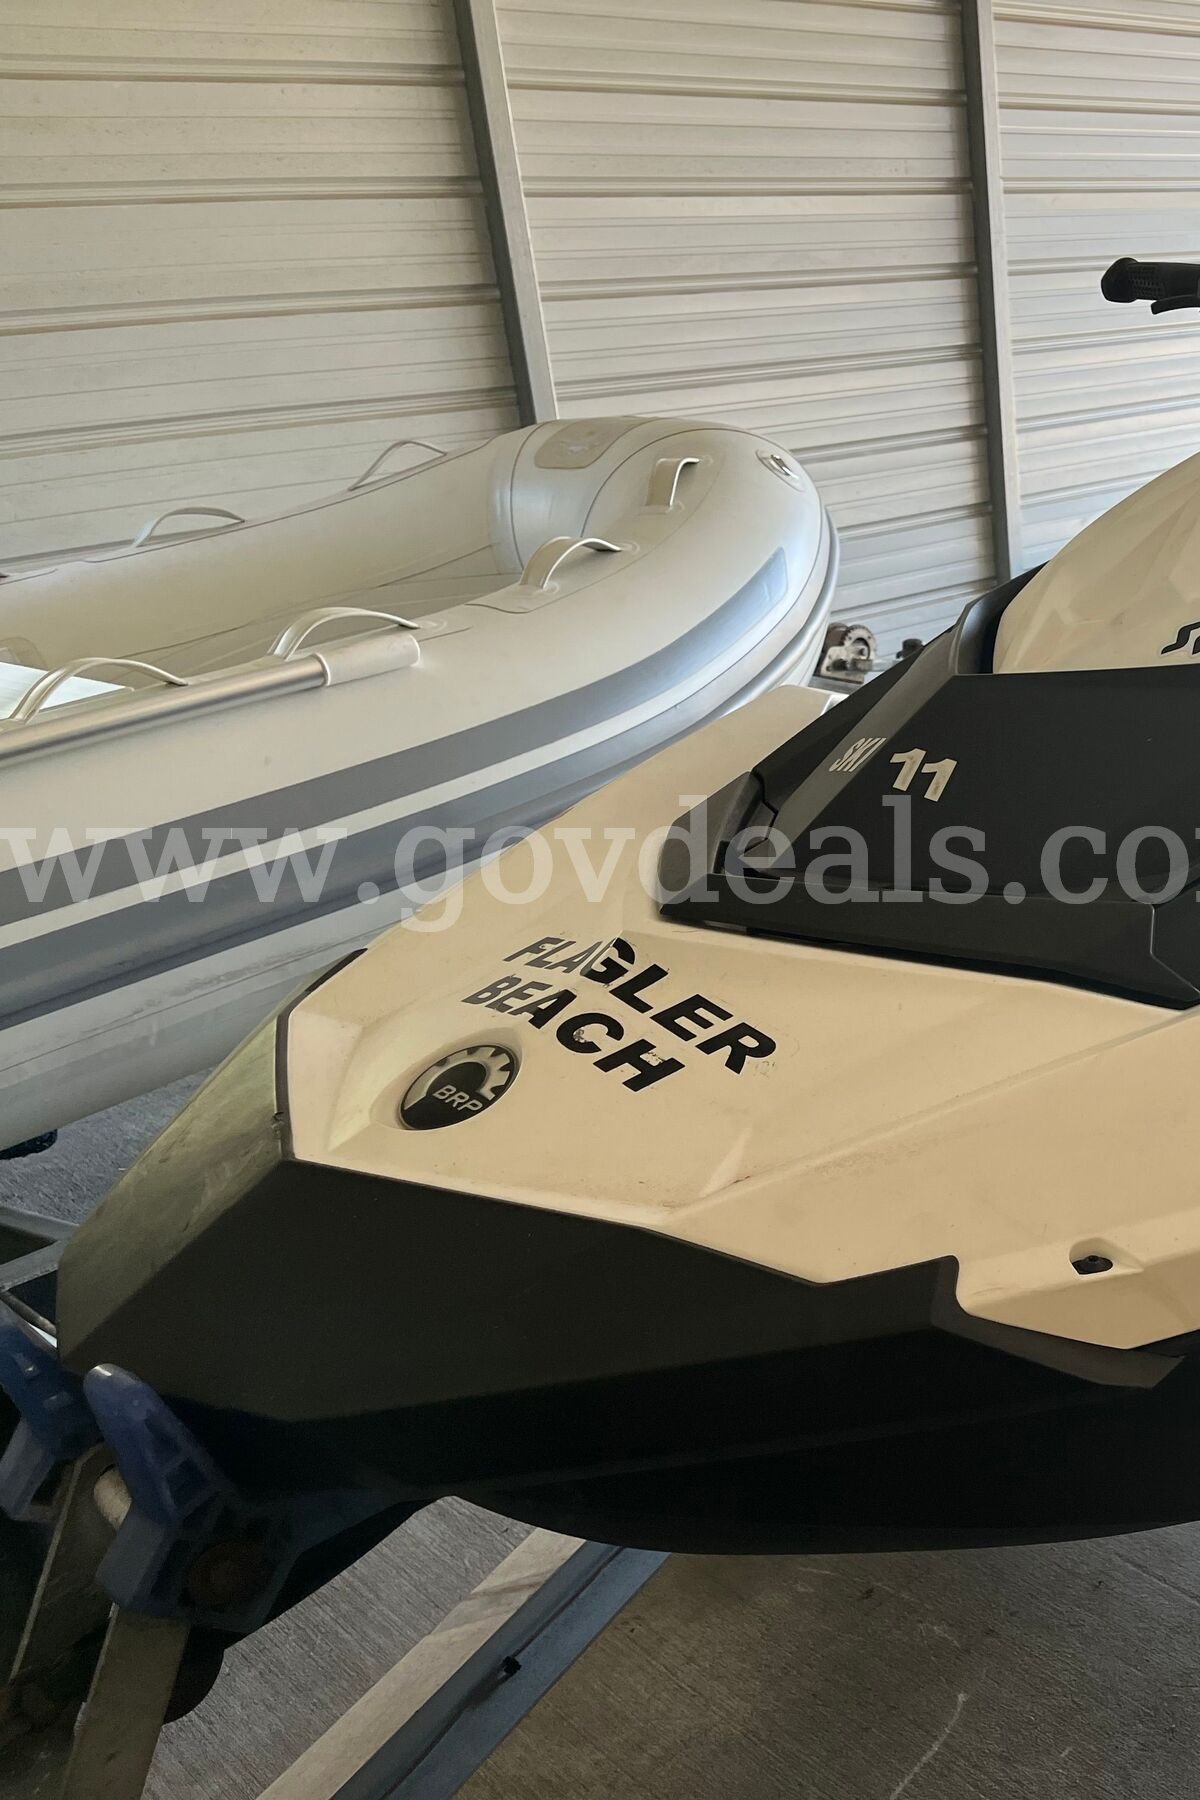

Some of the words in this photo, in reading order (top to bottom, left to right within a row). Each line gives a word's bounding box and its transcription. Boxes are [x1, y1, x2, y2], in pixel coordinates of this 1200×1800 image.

[828, 738, 887, 772] SKI
[889, 748, 958, 802] 11
[461, 974, 686, 1092] BEACH
[502, 936, 777, 1075] FLAGLER
[432, 1084, 484, 1113] BRP
